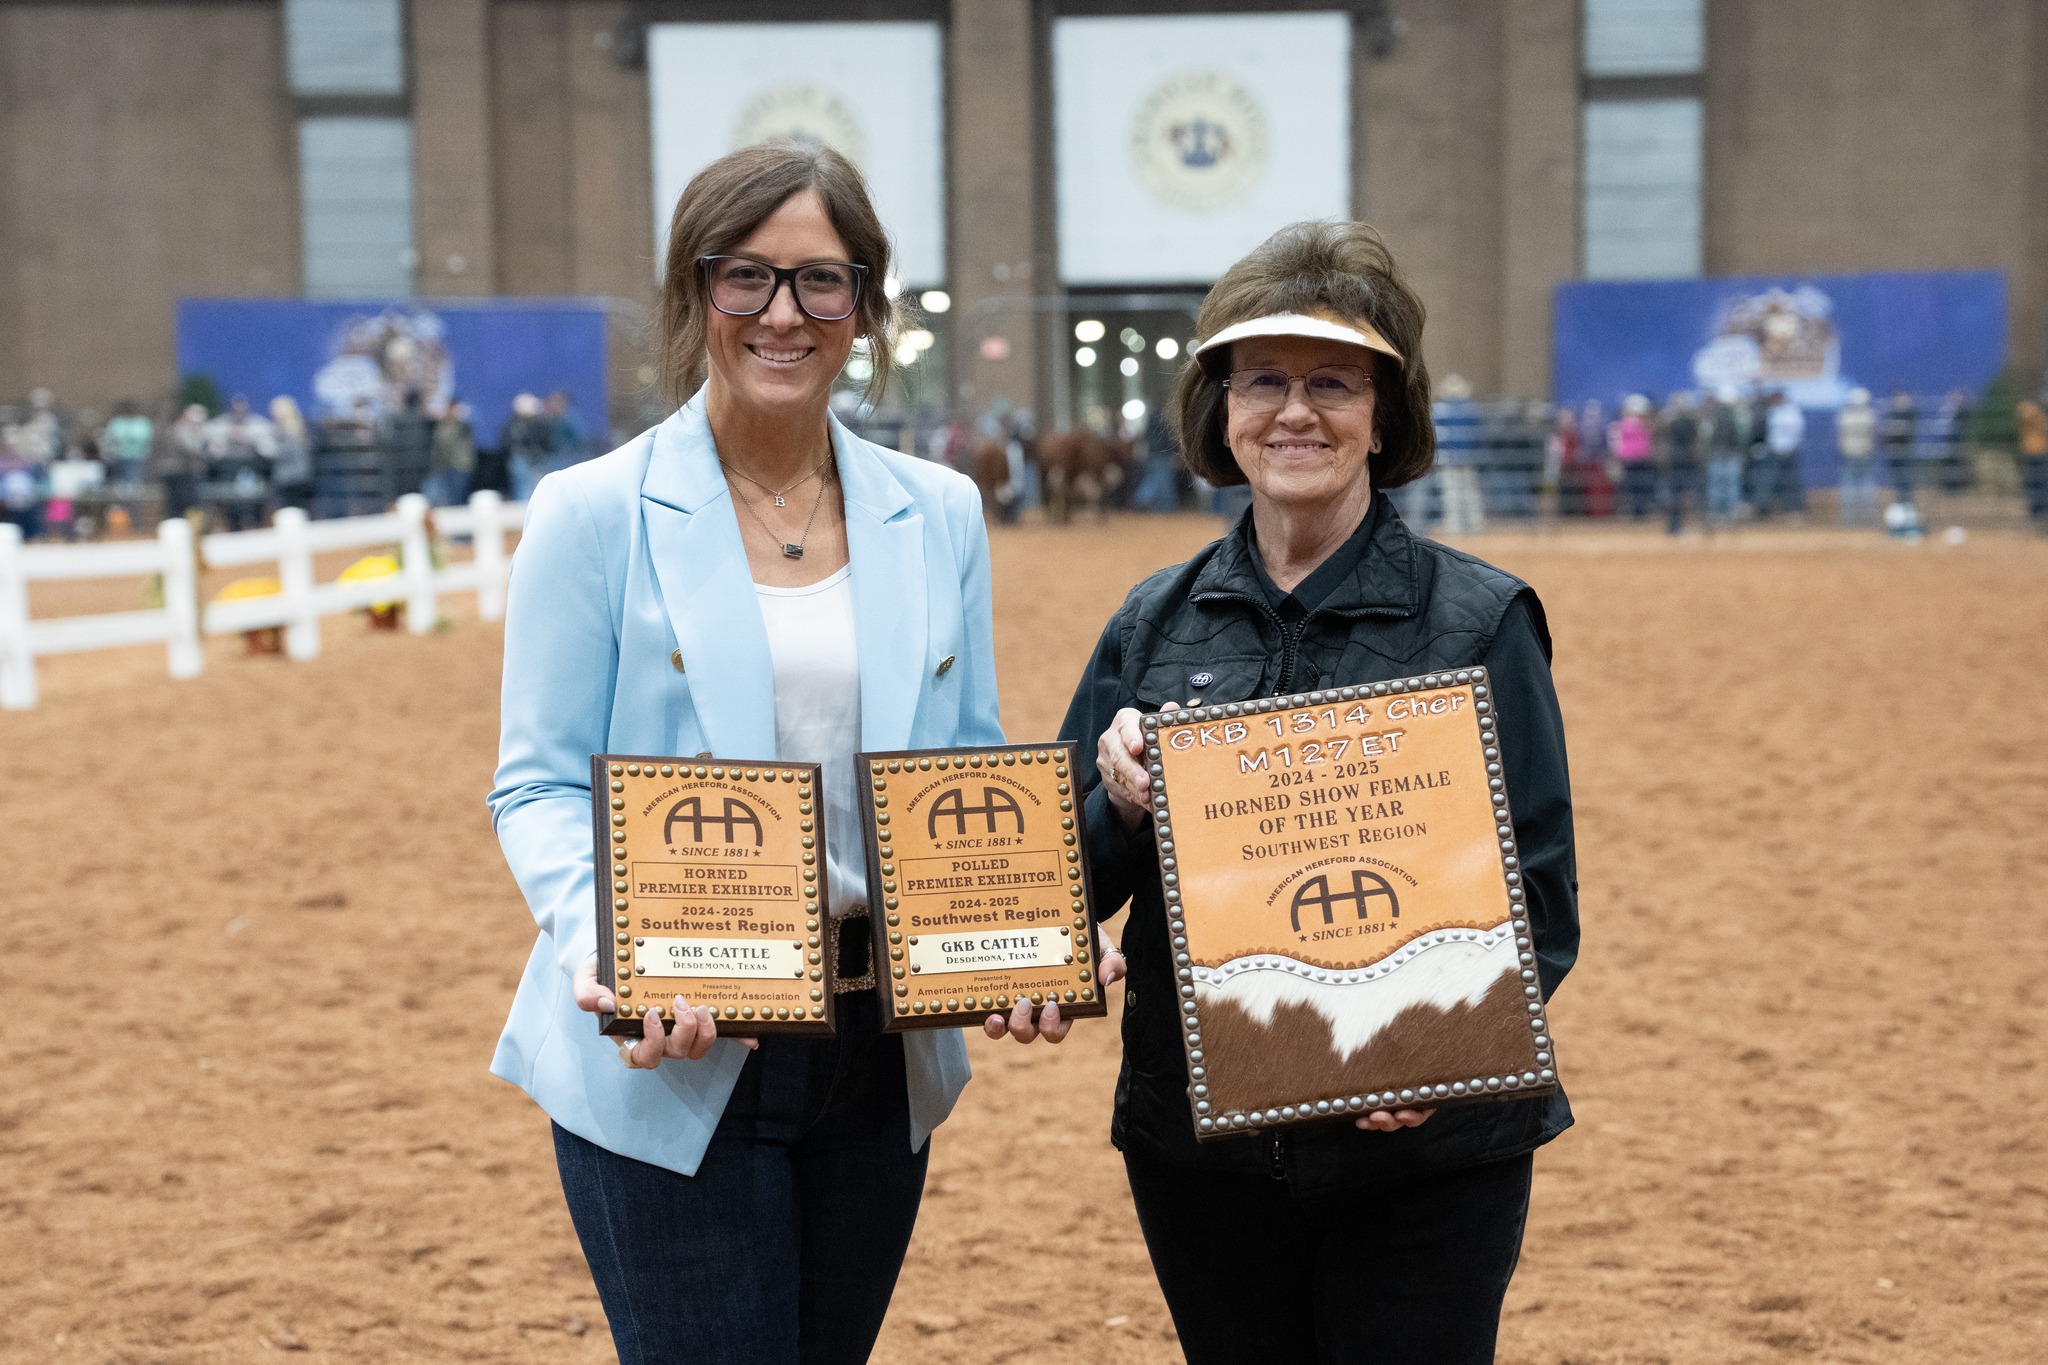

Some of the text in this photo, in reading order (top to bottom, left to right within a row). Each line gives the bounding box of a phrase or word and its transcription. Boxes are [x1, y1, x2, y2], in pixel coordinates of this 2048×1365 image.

[1170, 694, 1465, 751] GKB 1314 Cher
[1268, 769, 1315, 789] 2024
[1333, 759, 1380, 780] 2025
[642, 781, 782, 822] AMERICAN HEREFORD ASSOCIATION
[906, 772, 1042, 814] AMERICAN HEREFORD ASSOCIATION
[1204, 770, 1452, 820] HORNED SHOW FEMALE
[1259, 799, 1405, 836] OF THE YEAR
[681, 847, 749, 858] SINCE 1881
[946, 837, 1012, 850] SINCE 1881
[684, 868, 748, 880] HORNED
[952, 858, 1010, 872] POLLED
[638, 883, 793, 896] PREMIER EXHIBITOR
[907, 872, 1056, 890] PREMIER EXHIBITOR
[1266, 855, 1419, 907] AMERICAN HEREFORD ASSOCIATION
[641, 918, 795, 934] Southwest Region
[911, 908, 1060, 927] Southwest Region
[1312, 922, 1386, 942] SINCE 1881
[668, 946, 770, 959] GKB CATTLE
[941, 936, 1040, 952] GKB CATTLE
[918, 978, 1069, 996] American Hereford Association
[694, 992, 738, 1000] Hereford
[741, 992, 800, 1001] Association
